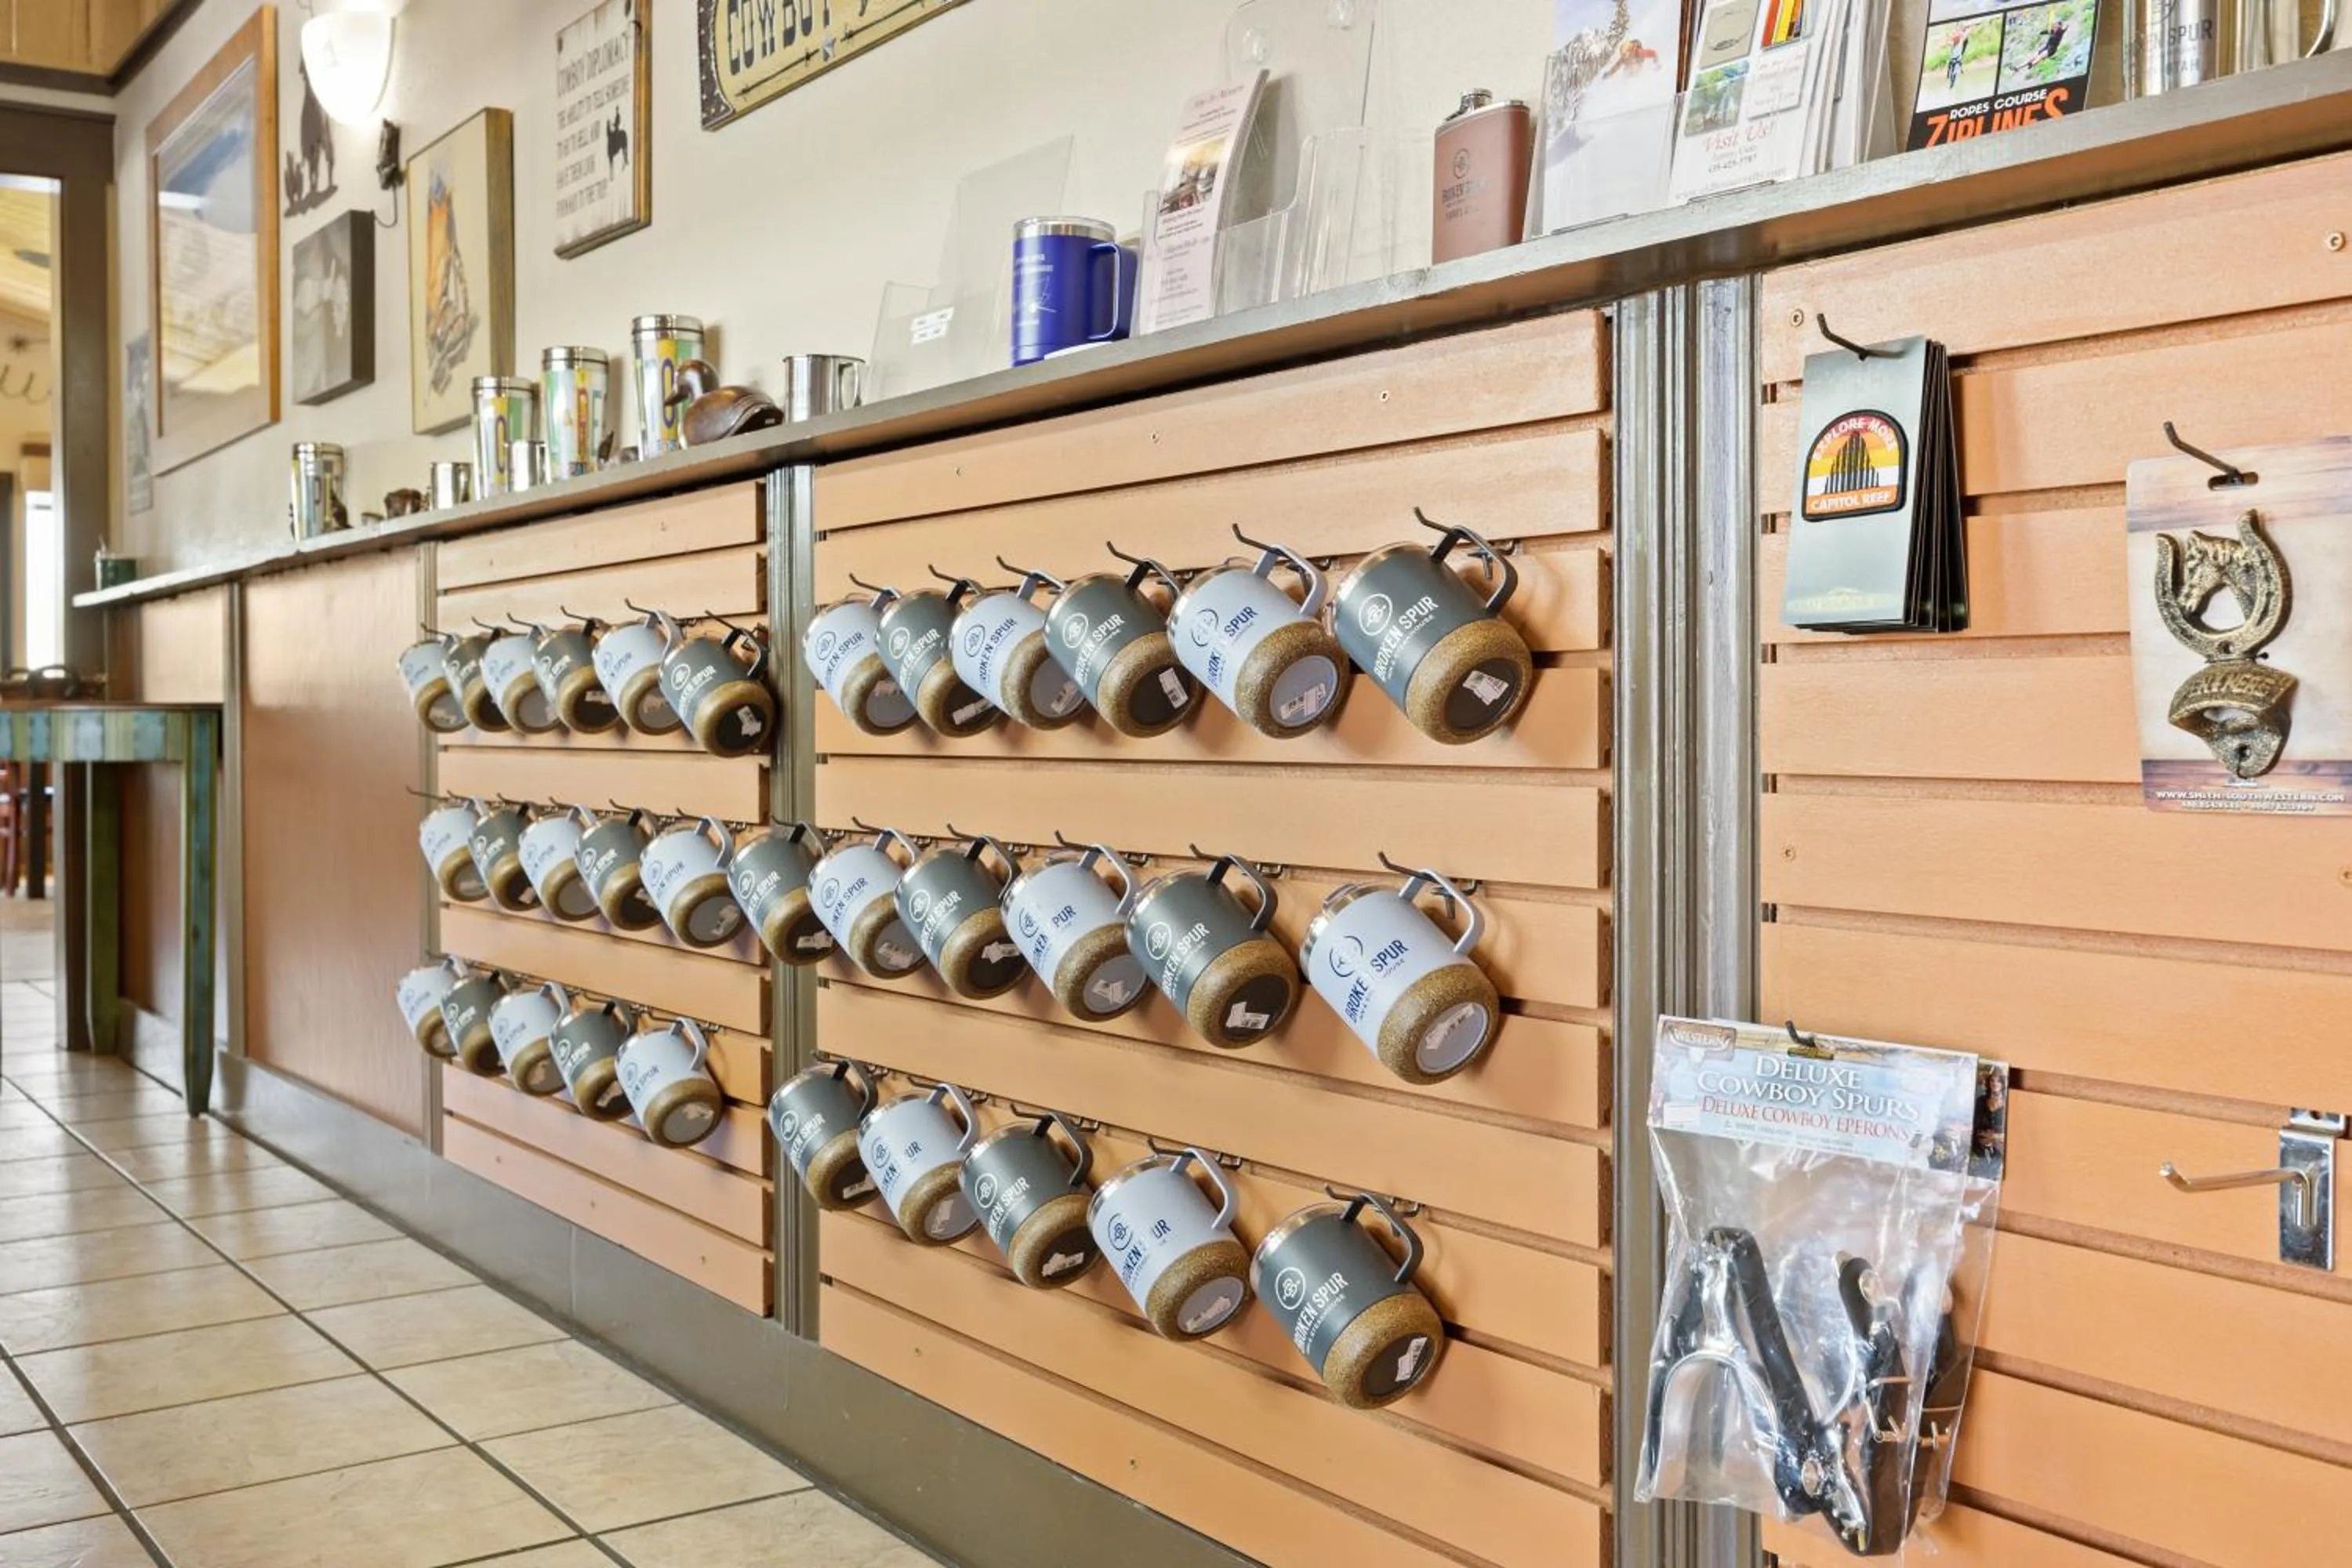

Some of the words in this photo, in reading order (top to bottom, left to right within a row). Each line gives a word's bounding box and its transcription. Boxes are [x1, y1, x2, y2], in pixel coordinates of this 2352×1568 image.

[2169, 19, 2212, 45] SPUR
[1926, 87, 2069, 149] ZIPLINES
[1950, 101, 1990, 120] ROPES
[1994, 89, 2048, 111] COURSE
[1812, 416, 1867, 461] EXPLORE
[1867, 418, 1898, 452] MORE
[1811, 495, 1860, 510] CAPITOL
[1861, 492, 1891, 506] REEF
[990, 616, 1018, 644] SPUR
[1092, 614, 1126, 641] SPUR
[1224, 605, 1259, 638] SPUR
[839, 631, 866, 655] SPUR
[914, 628, 942, 654] SPUR
[1374, 625, 1404, 683] BROKEN
[1398, 596, 1439, 630] SPUR
[844, 877, 869, 901] SPUR
[934, 890, 963, 918] SPUR
[1051, 905, 1077, 928] PUR
[1178, 922, 1210, 955] SPUR
[1345, 976, 1370, 1024] BROKE
[1370, 939, 1410, 972] SPUR
[1755, 1054, 1864, 1090] DELUXE
[1697, 1069, 1825, 1107] COWBOY
[1831, 1088, 1919, 1121] SPURS
[800, 1112, 826, 1139] SPUR
[1701, 1096, 1759, 1119] DELUXE
[1761, 1105, 1835, 1129] COWBOY
[1000, 1176, 1030, 1207] SPUR
[1312, 1272, 1349, 1308] SPUR
